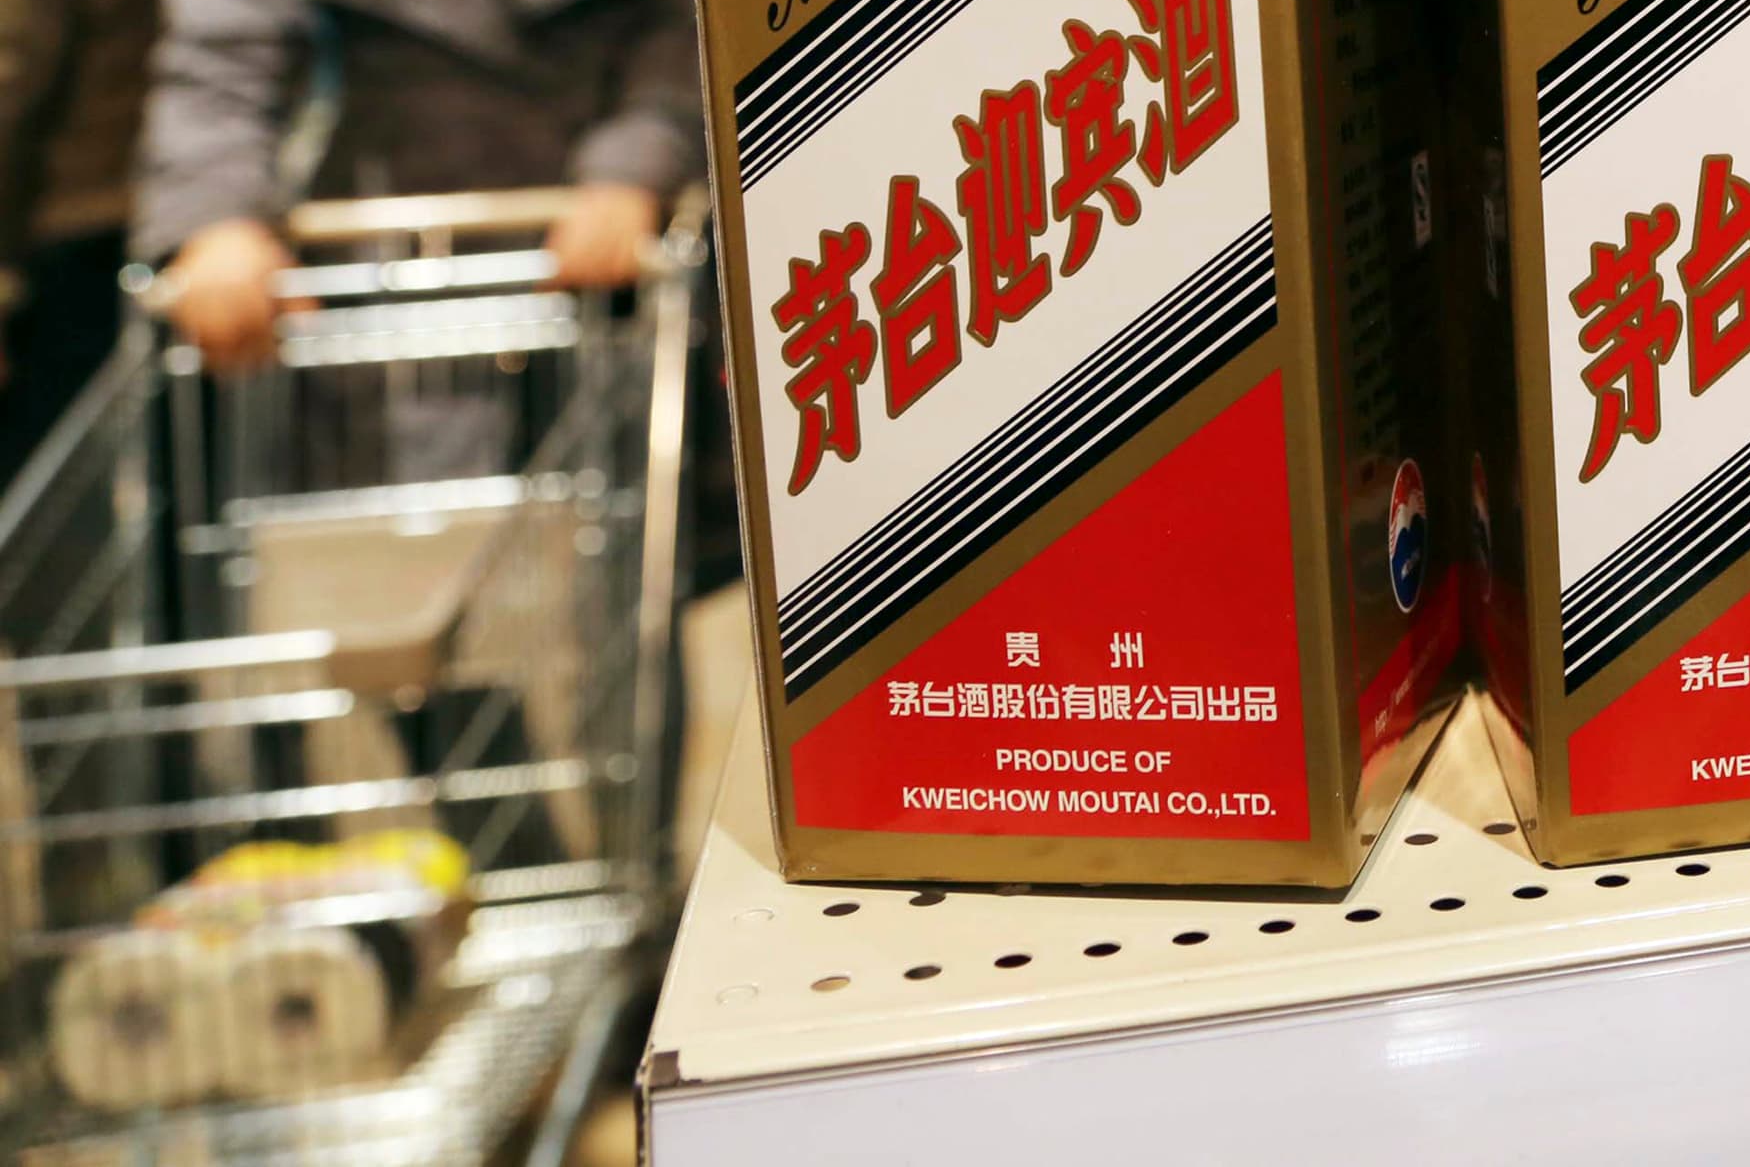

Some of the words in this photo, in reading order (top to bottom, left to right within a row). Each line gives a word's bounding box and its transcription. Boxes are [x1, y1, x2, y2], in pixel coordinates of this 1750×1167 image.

[888, 681, 1277, 721] 茅台酒股份有限公司出品
[996, 749, 1127, 772] PRODUCE
[1134, 750, 1171, 772] OF
[903, 787, 1049, 812] KWEICHOW
[1058, 790, 1159, 814] MOUTAI
[1167, 792, 1277, 818] CO.,LTD.
